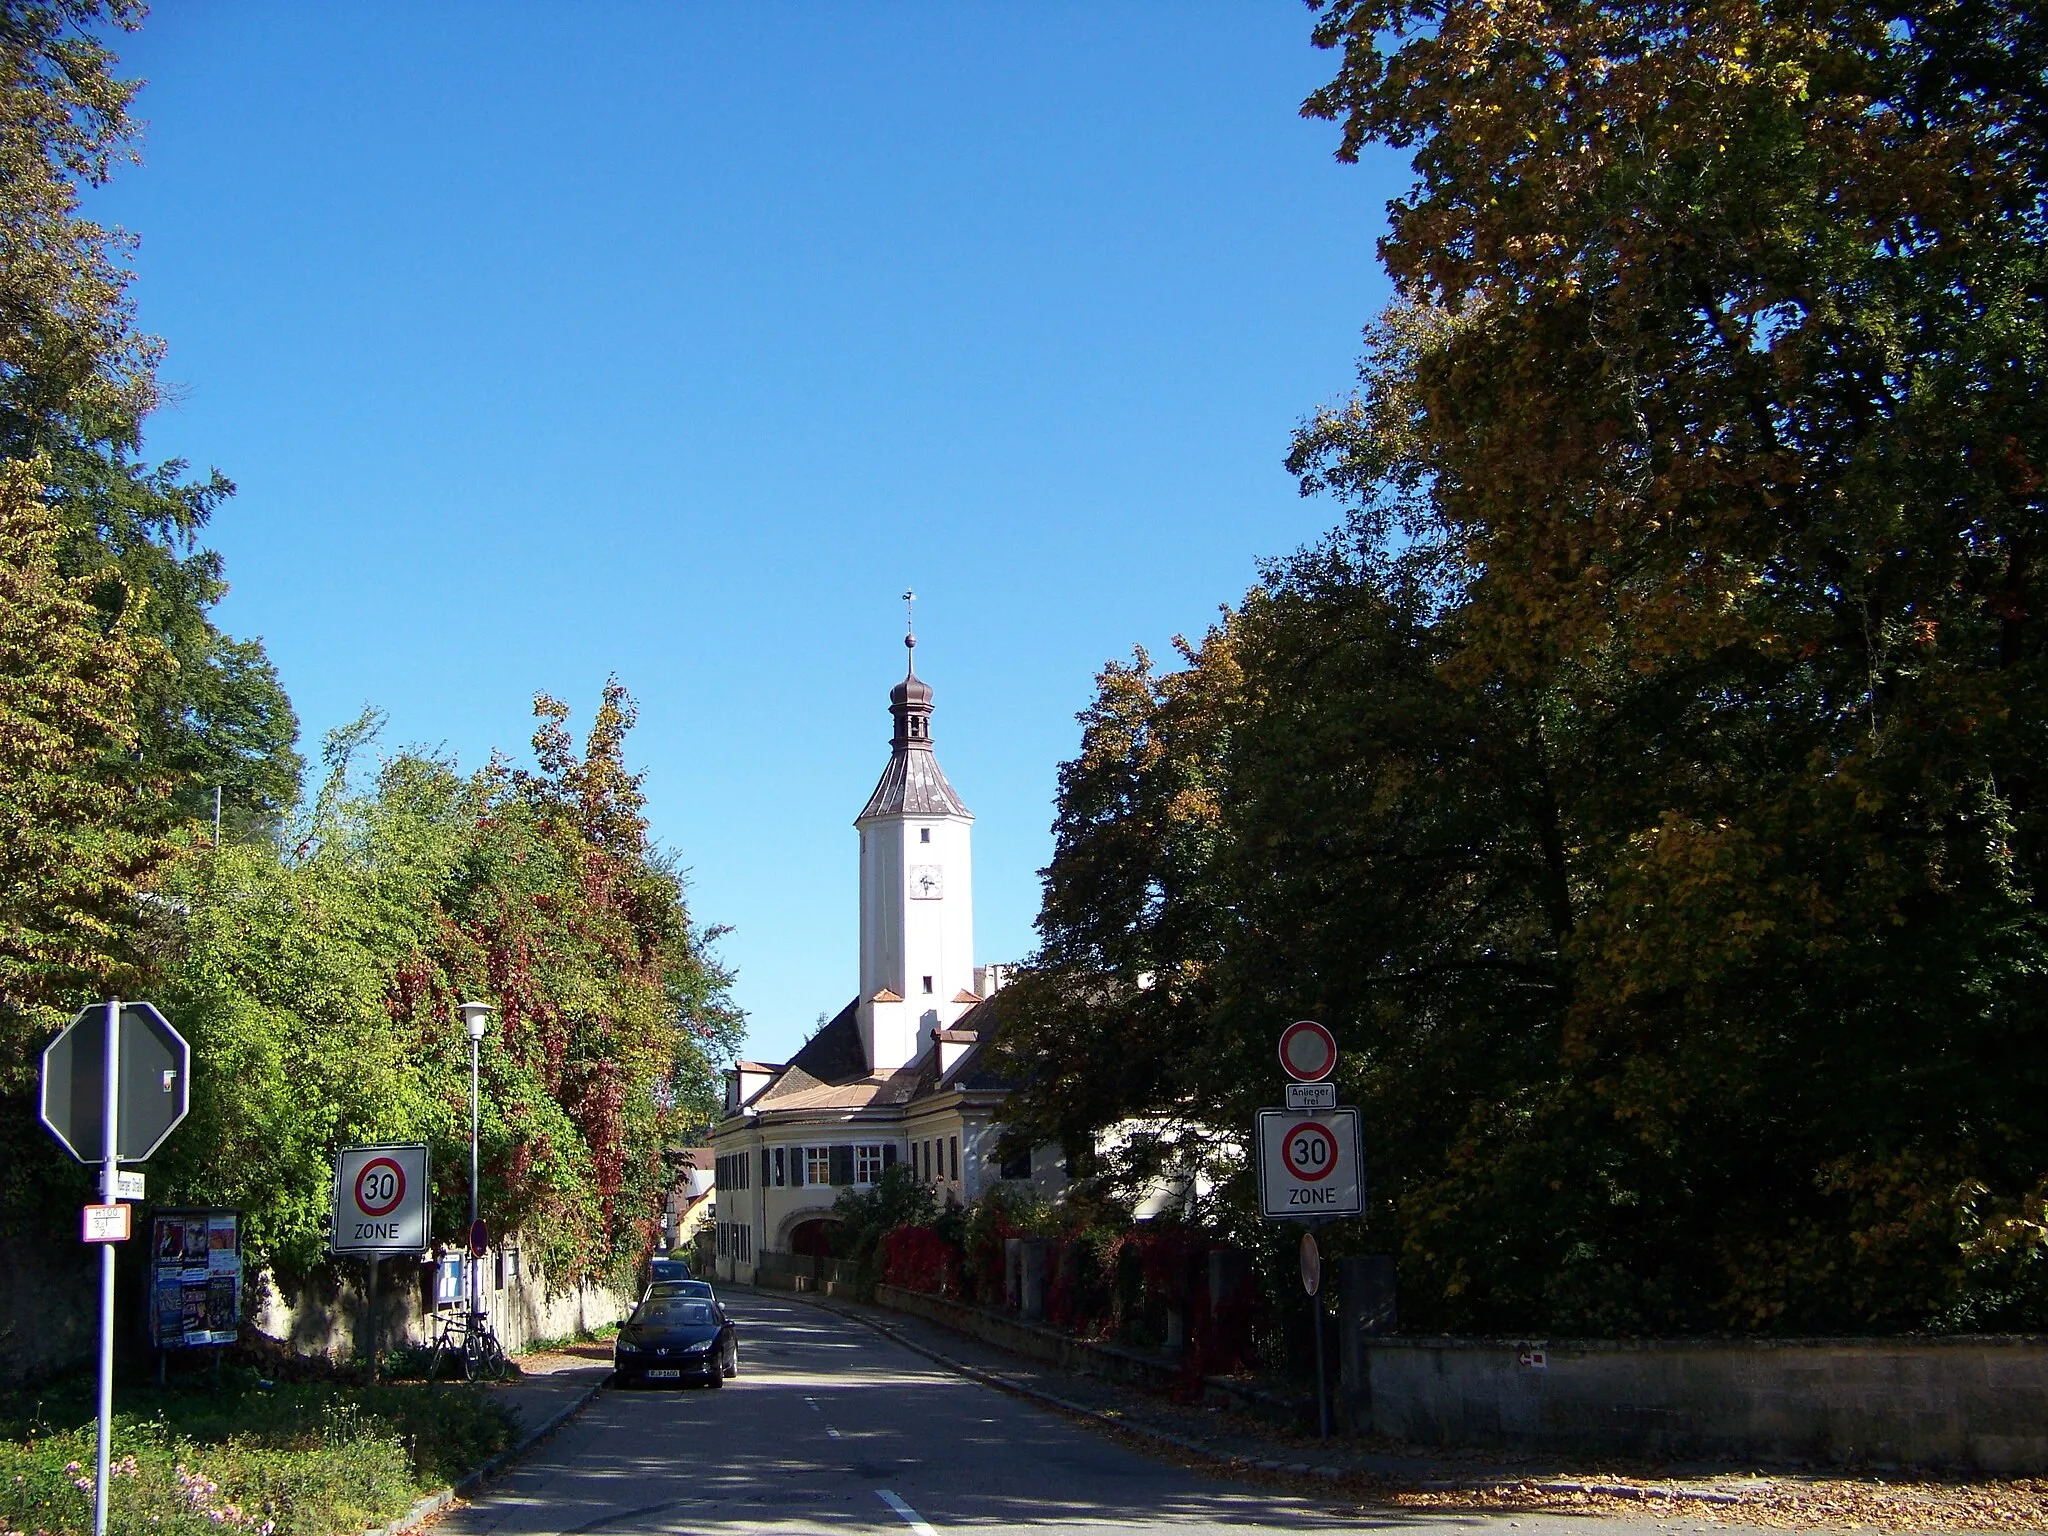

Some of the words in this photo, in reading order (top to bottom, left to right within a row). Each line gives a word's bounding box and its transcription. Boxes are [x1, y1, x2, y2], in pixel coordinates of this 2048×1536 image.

[1292, 1088, 1329, 1097] Anlieger
[1304, 1096, 1319, 1106] frei
[1294, 1138, 1326, 1165] 30
[364, 1173, 395, 1200] 30
[1289, 1188, 1336, 1205] ZONE
[354, 1223, 400, 1240] ZONE
